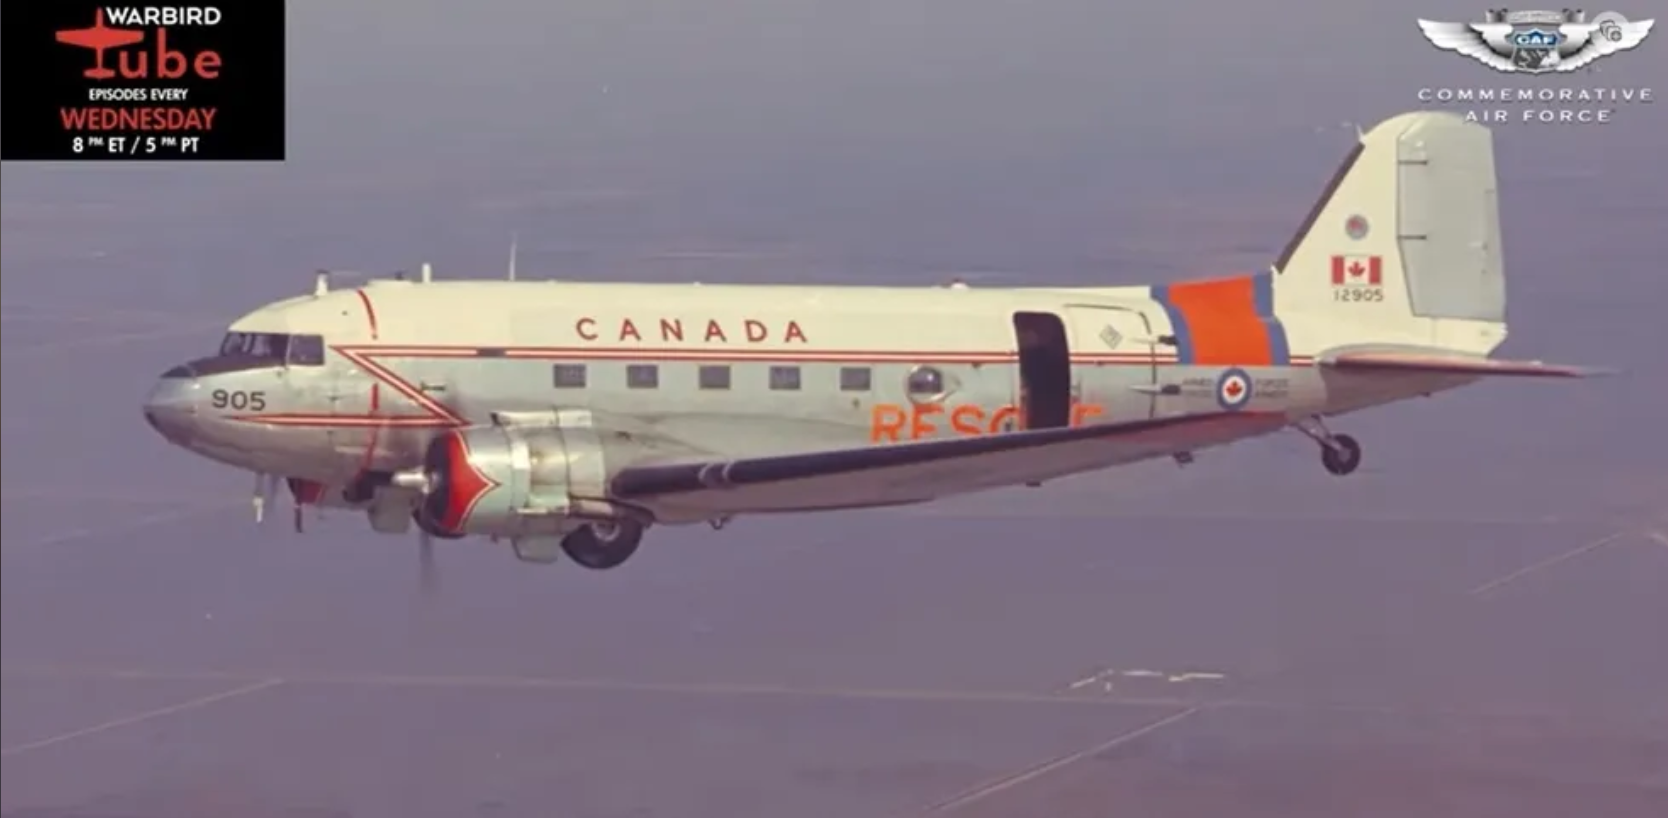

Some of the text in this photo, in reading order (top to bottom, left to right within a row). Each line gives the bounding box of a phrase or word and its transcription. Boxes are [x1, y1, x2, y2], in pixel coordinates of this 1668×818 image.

[1333, 289, 1384, 301] 12905
[576, 317, 808, 343] CANADA
[212, 389, 266, 411] 905
